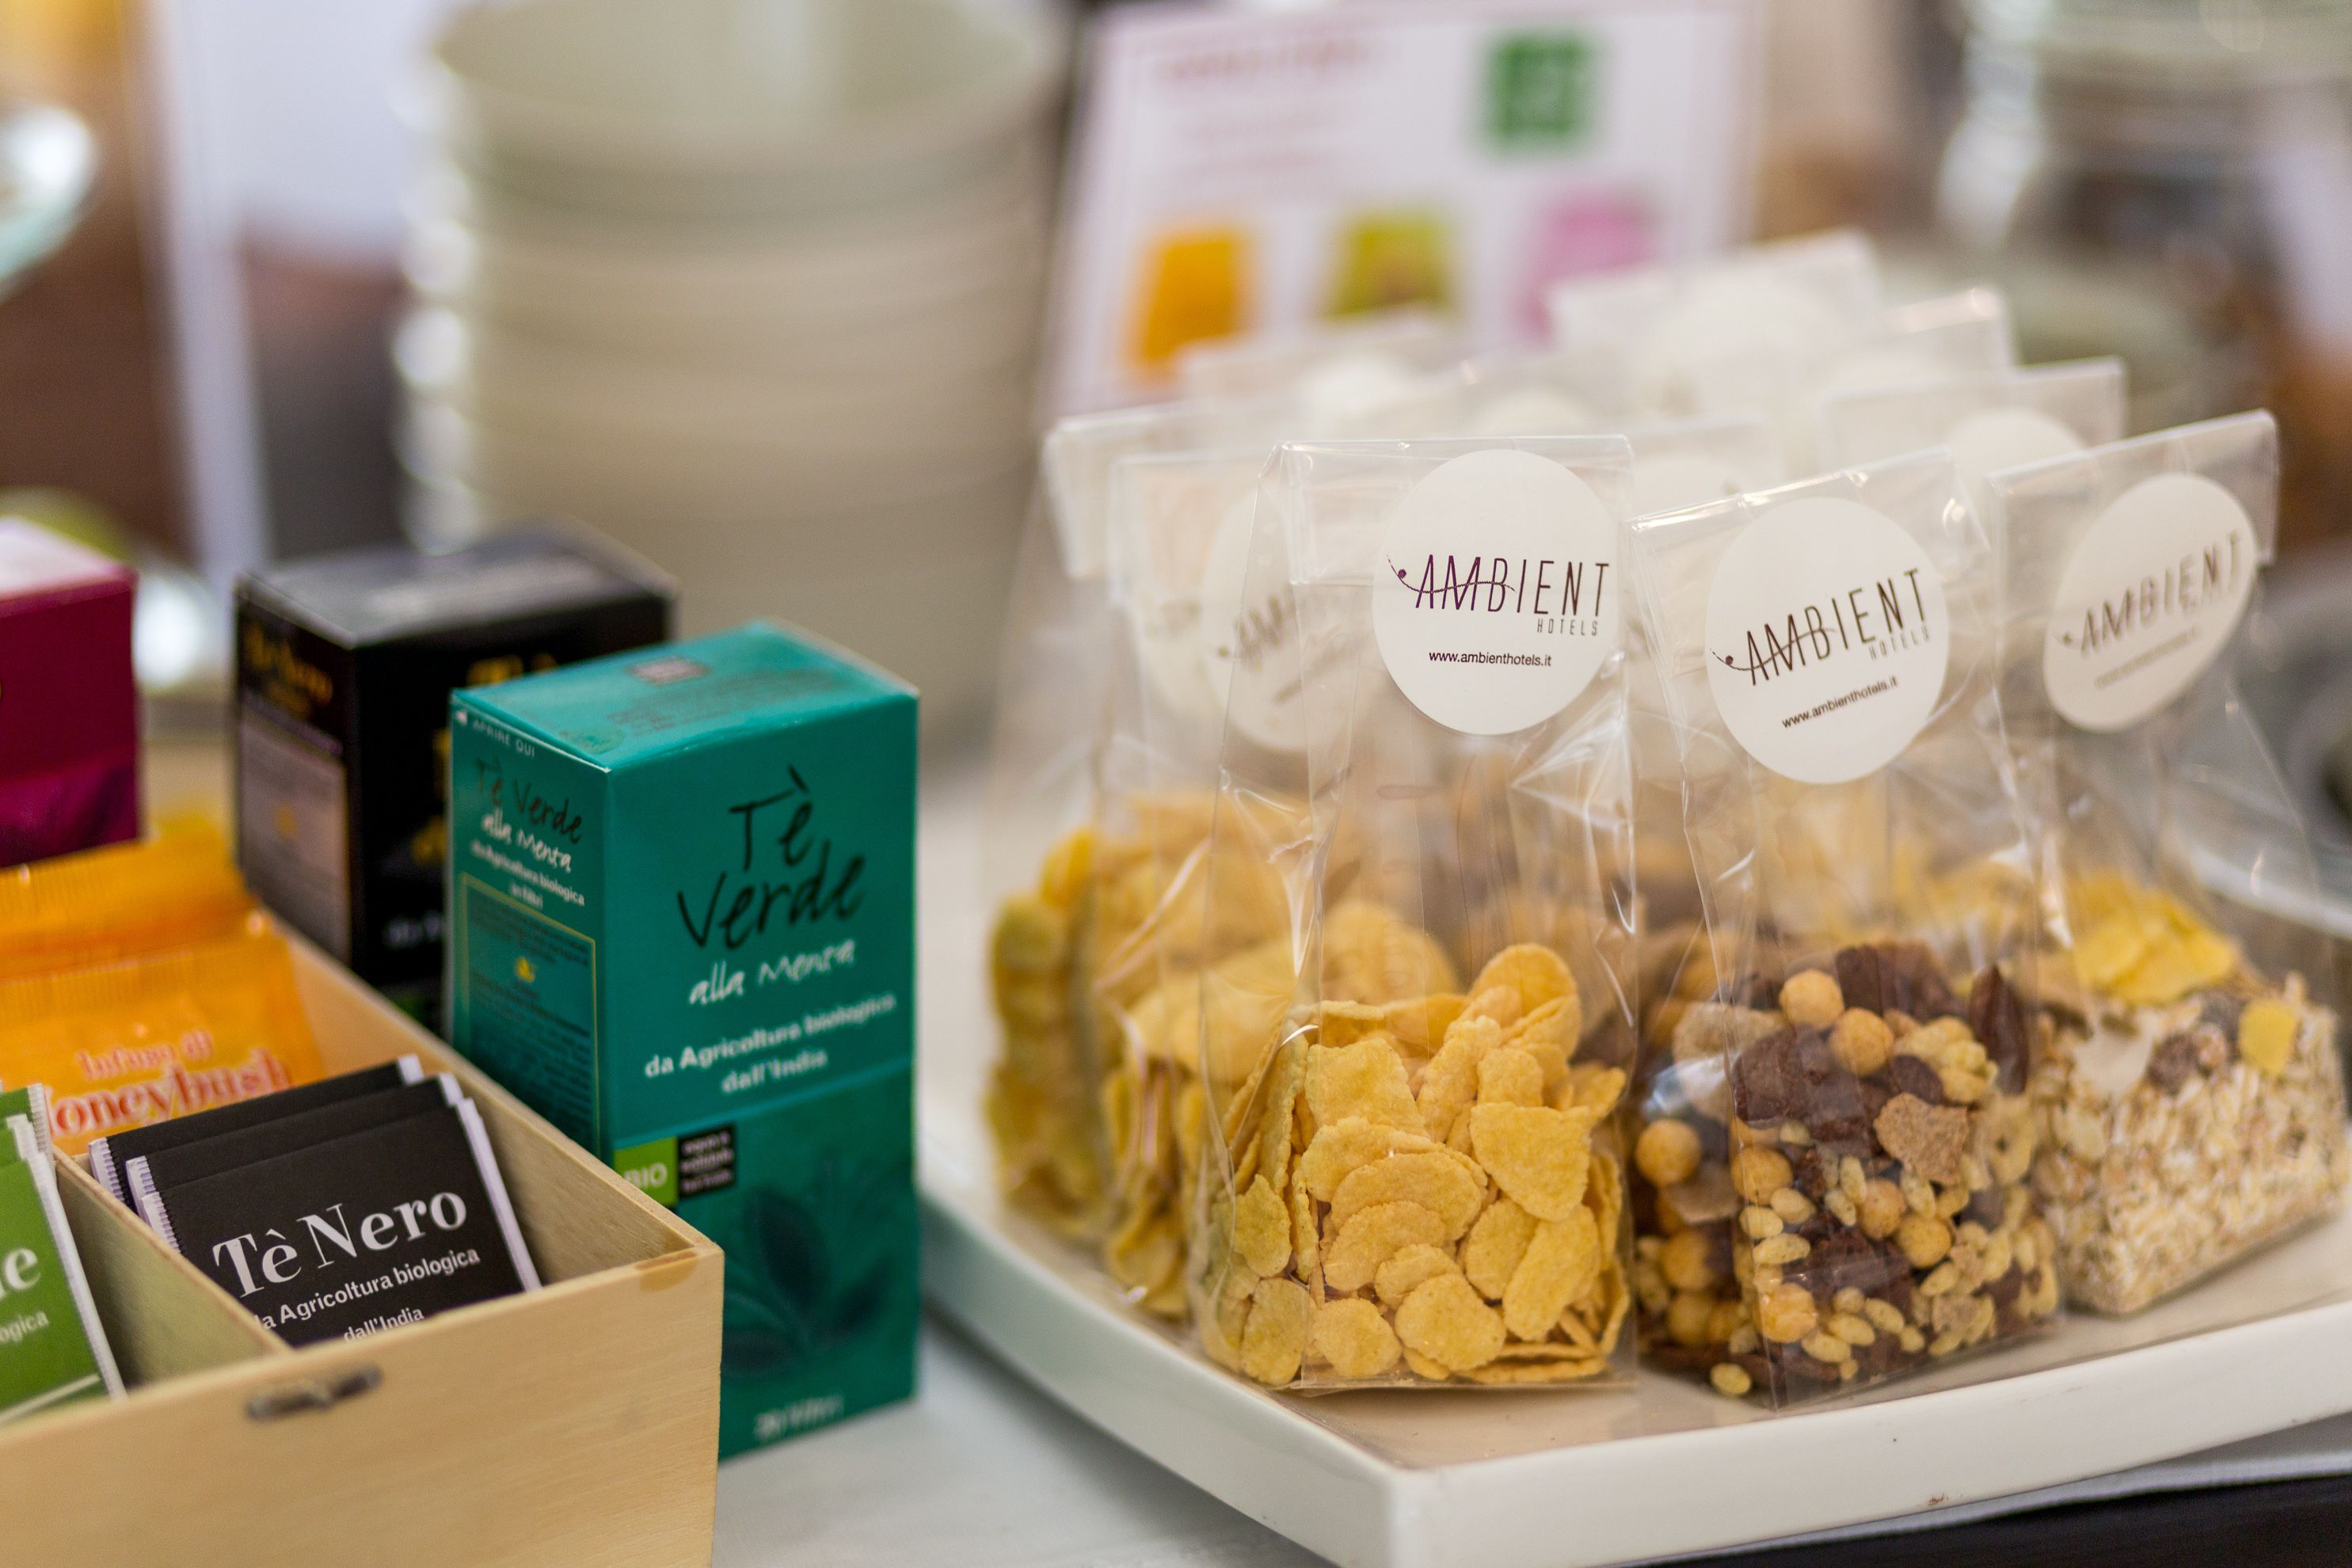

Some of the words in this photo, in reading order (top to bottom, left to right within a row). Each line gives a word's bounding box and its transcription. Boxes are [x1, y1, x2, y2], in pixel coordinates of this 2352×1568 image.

[1414, 554, 1609, 617] AMBIENT
[2081, 530, 2240, 657] AMBIENT
[1429, 651, 1552, 668] www.ambienthotels.it
[1537, 618, 1599, 637] HOTELS
[1745, 568, 1926, 687] AMBIENT
[1867, 625, 1930, 660] HOTELS
[1782, 675, 1898, 729] www.ambienthotels.it
[481, 808, 512, 846] alla
[517, 828, 573, 873] Menta
[513, 780, 583, 845] Verde
[728, 763, 813, 873] Tè
[539, 873, 585, 907] biologica
[678, 838, 866, 950] Verde
[688, 960, 746, 1007] alla
[757, 939, 856, 988] Menta
[645, 1054, 674, 1079] da
[679, 1023, 801, 1069] Agricoltura
[211, 1227, 302, 1299] Tè
[295, 1191, 468, 1269] Nero
[279, 1274, 394, 1325] Agricoltura
[395, 1246, 481, 1285] biologica
[343, 1306, 425, 1344] dall'India
